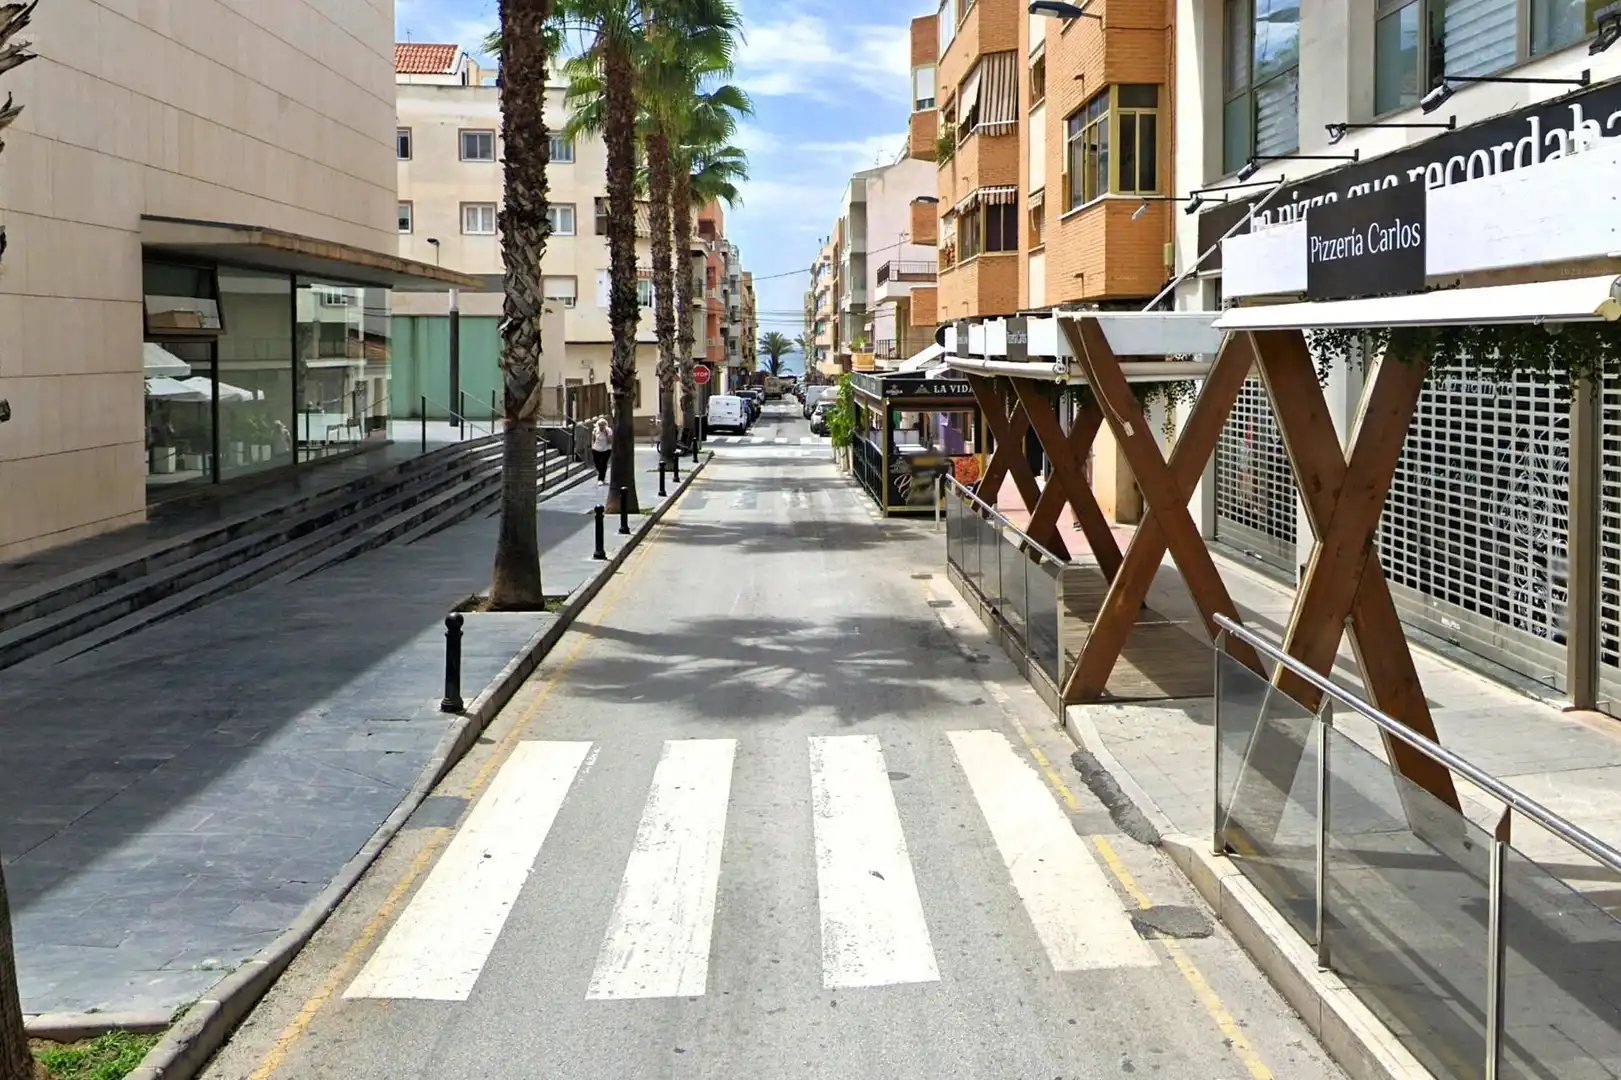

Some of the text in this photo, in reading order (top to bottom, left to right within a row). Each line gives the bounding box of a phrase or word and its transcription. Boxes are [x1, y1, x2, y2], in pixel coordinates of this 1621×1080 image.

[1310, 218, 1421, 264] Pizzería Carlos
[933, 384, 947, 394] LA
